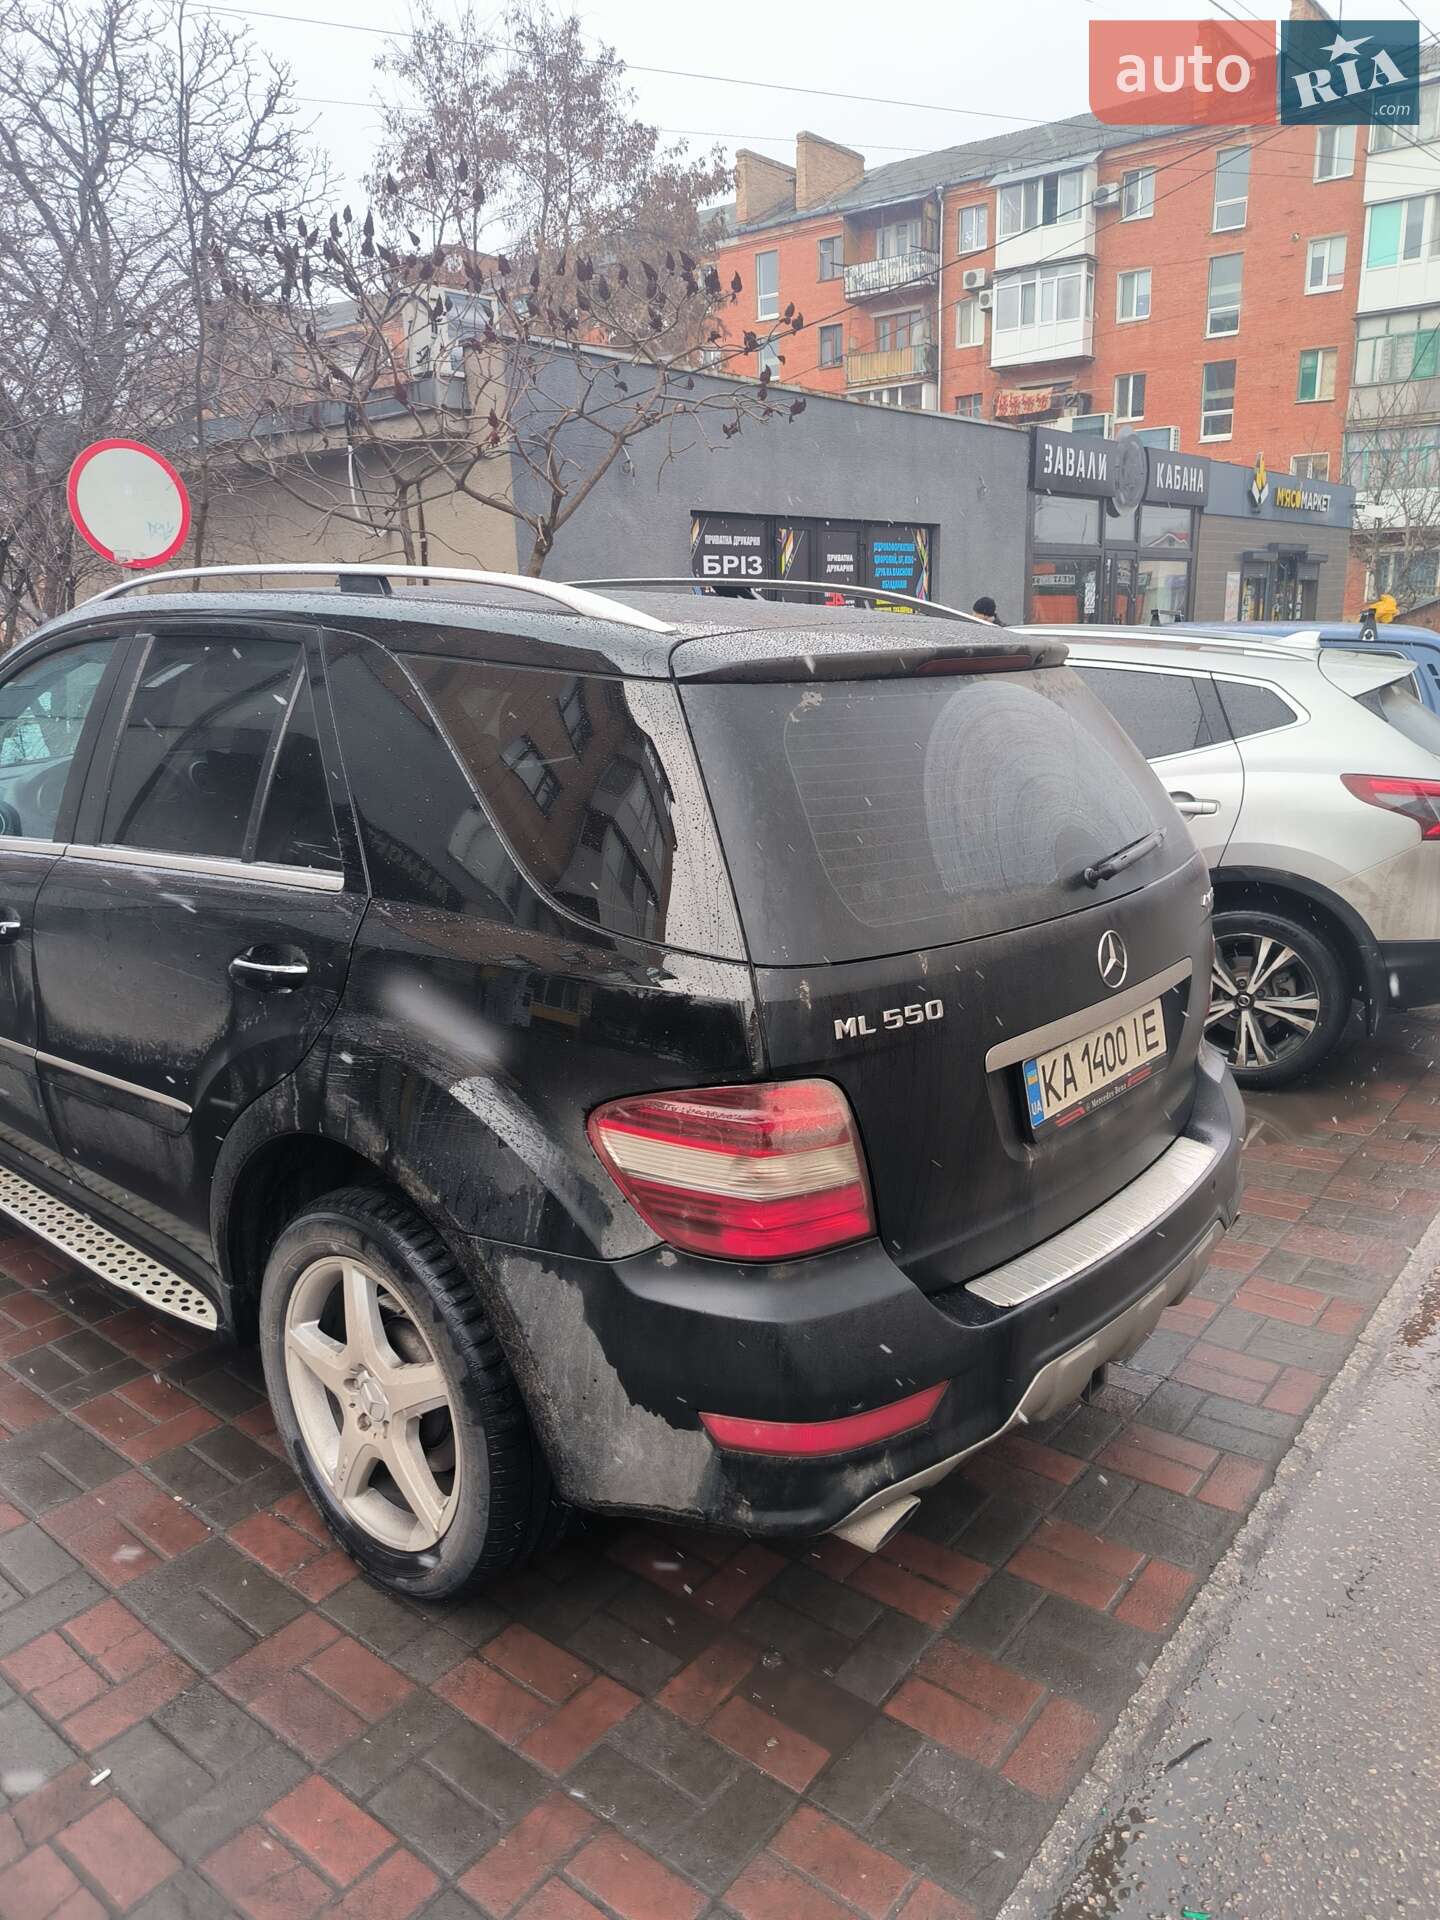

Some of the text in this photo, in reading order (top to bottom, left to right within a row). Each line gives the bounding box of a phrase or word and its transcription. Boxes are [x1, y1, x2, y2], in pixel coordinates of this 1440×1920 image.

[1043, 443, 1204, 493] ЗАВАЛИ КАБАНА
[702, 554, 763, 575] БРІЗ
[833, 999, 944, 1040] ML 550
[1041, 1008, 1160, 1108] KA 1400 IE
[1030, 1100, 1042, 1116] UA
